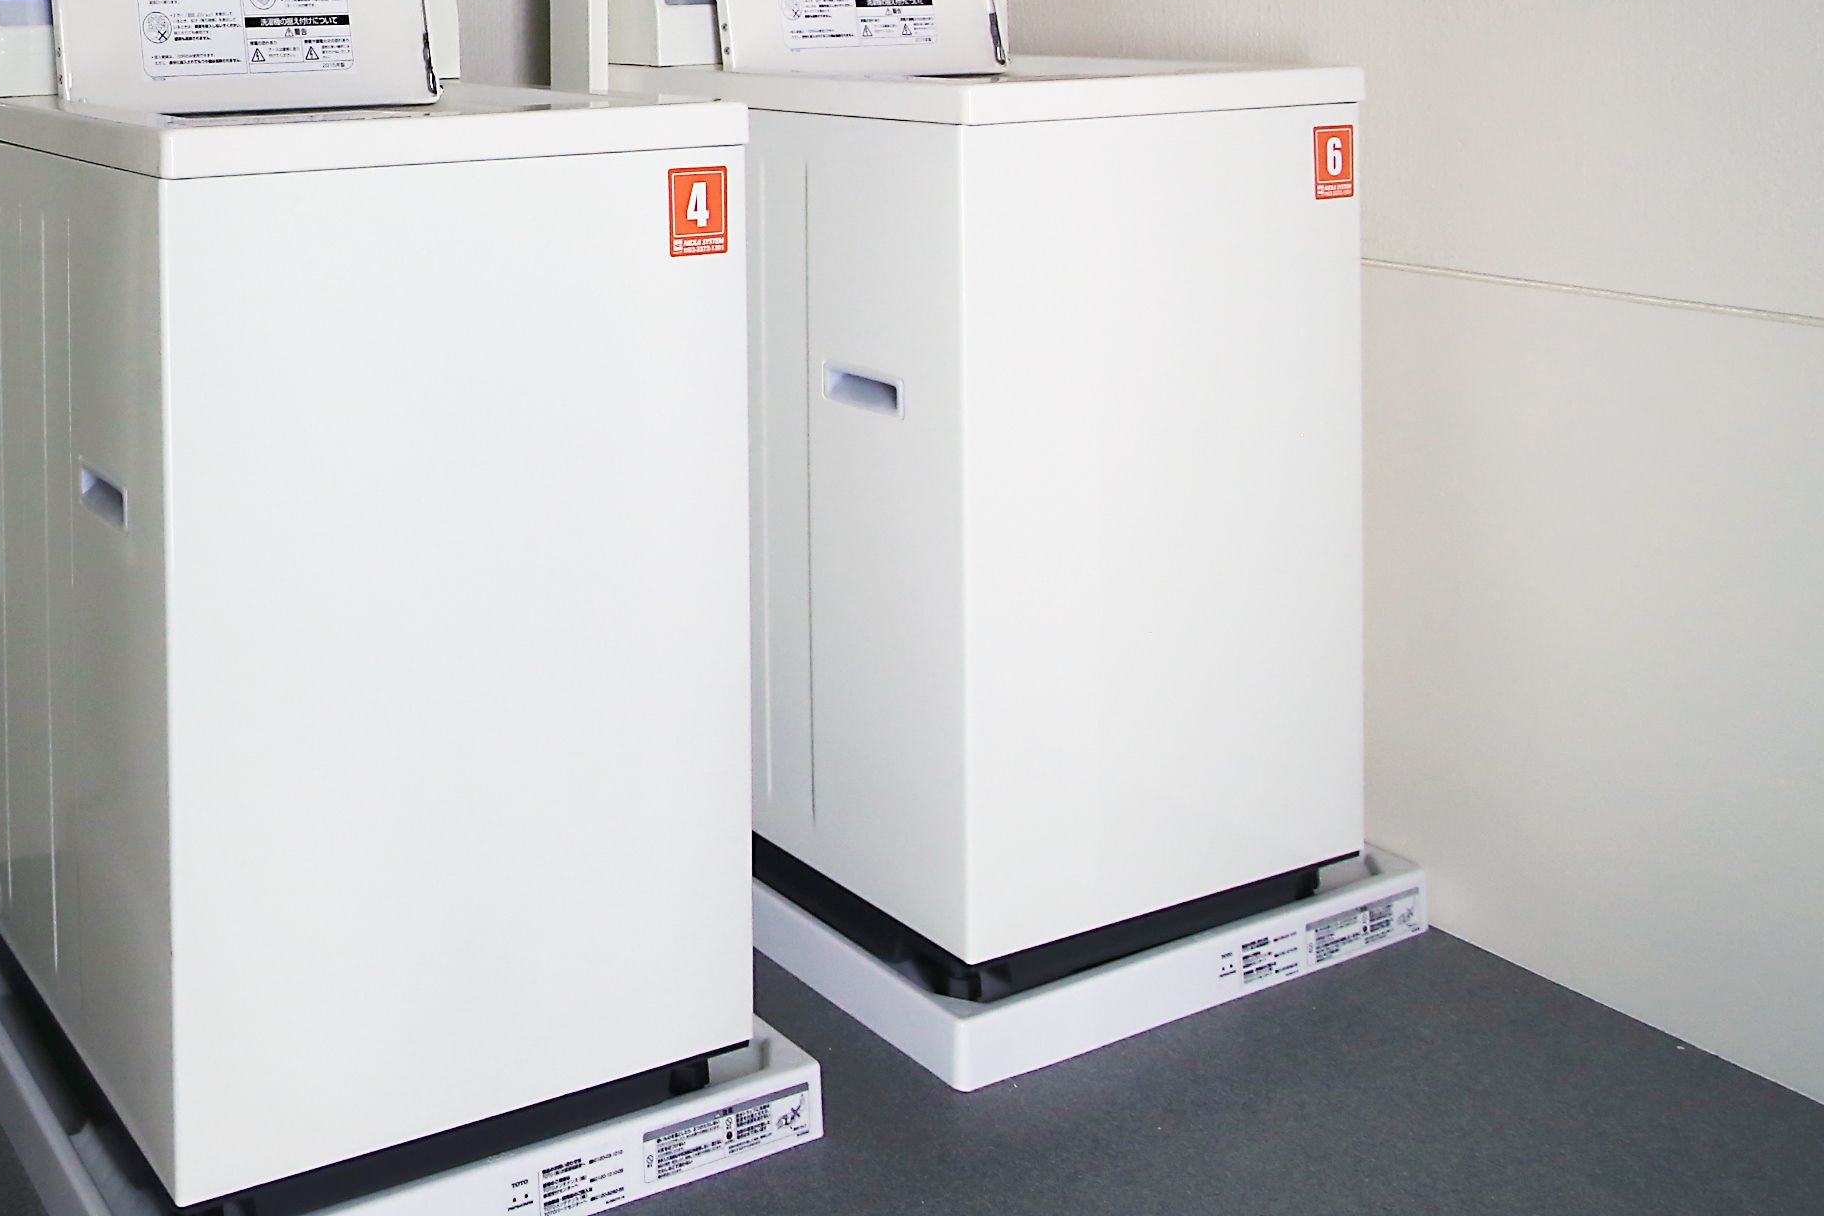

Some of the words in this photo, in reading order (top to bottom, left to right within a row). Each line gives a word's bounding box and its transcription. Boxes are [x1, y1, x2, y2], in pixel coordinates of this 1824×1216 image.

[295, 28, 307, 36] 警告
[1327, 137, 1342, 176] 6
[687, 182, 710, 227] 4
